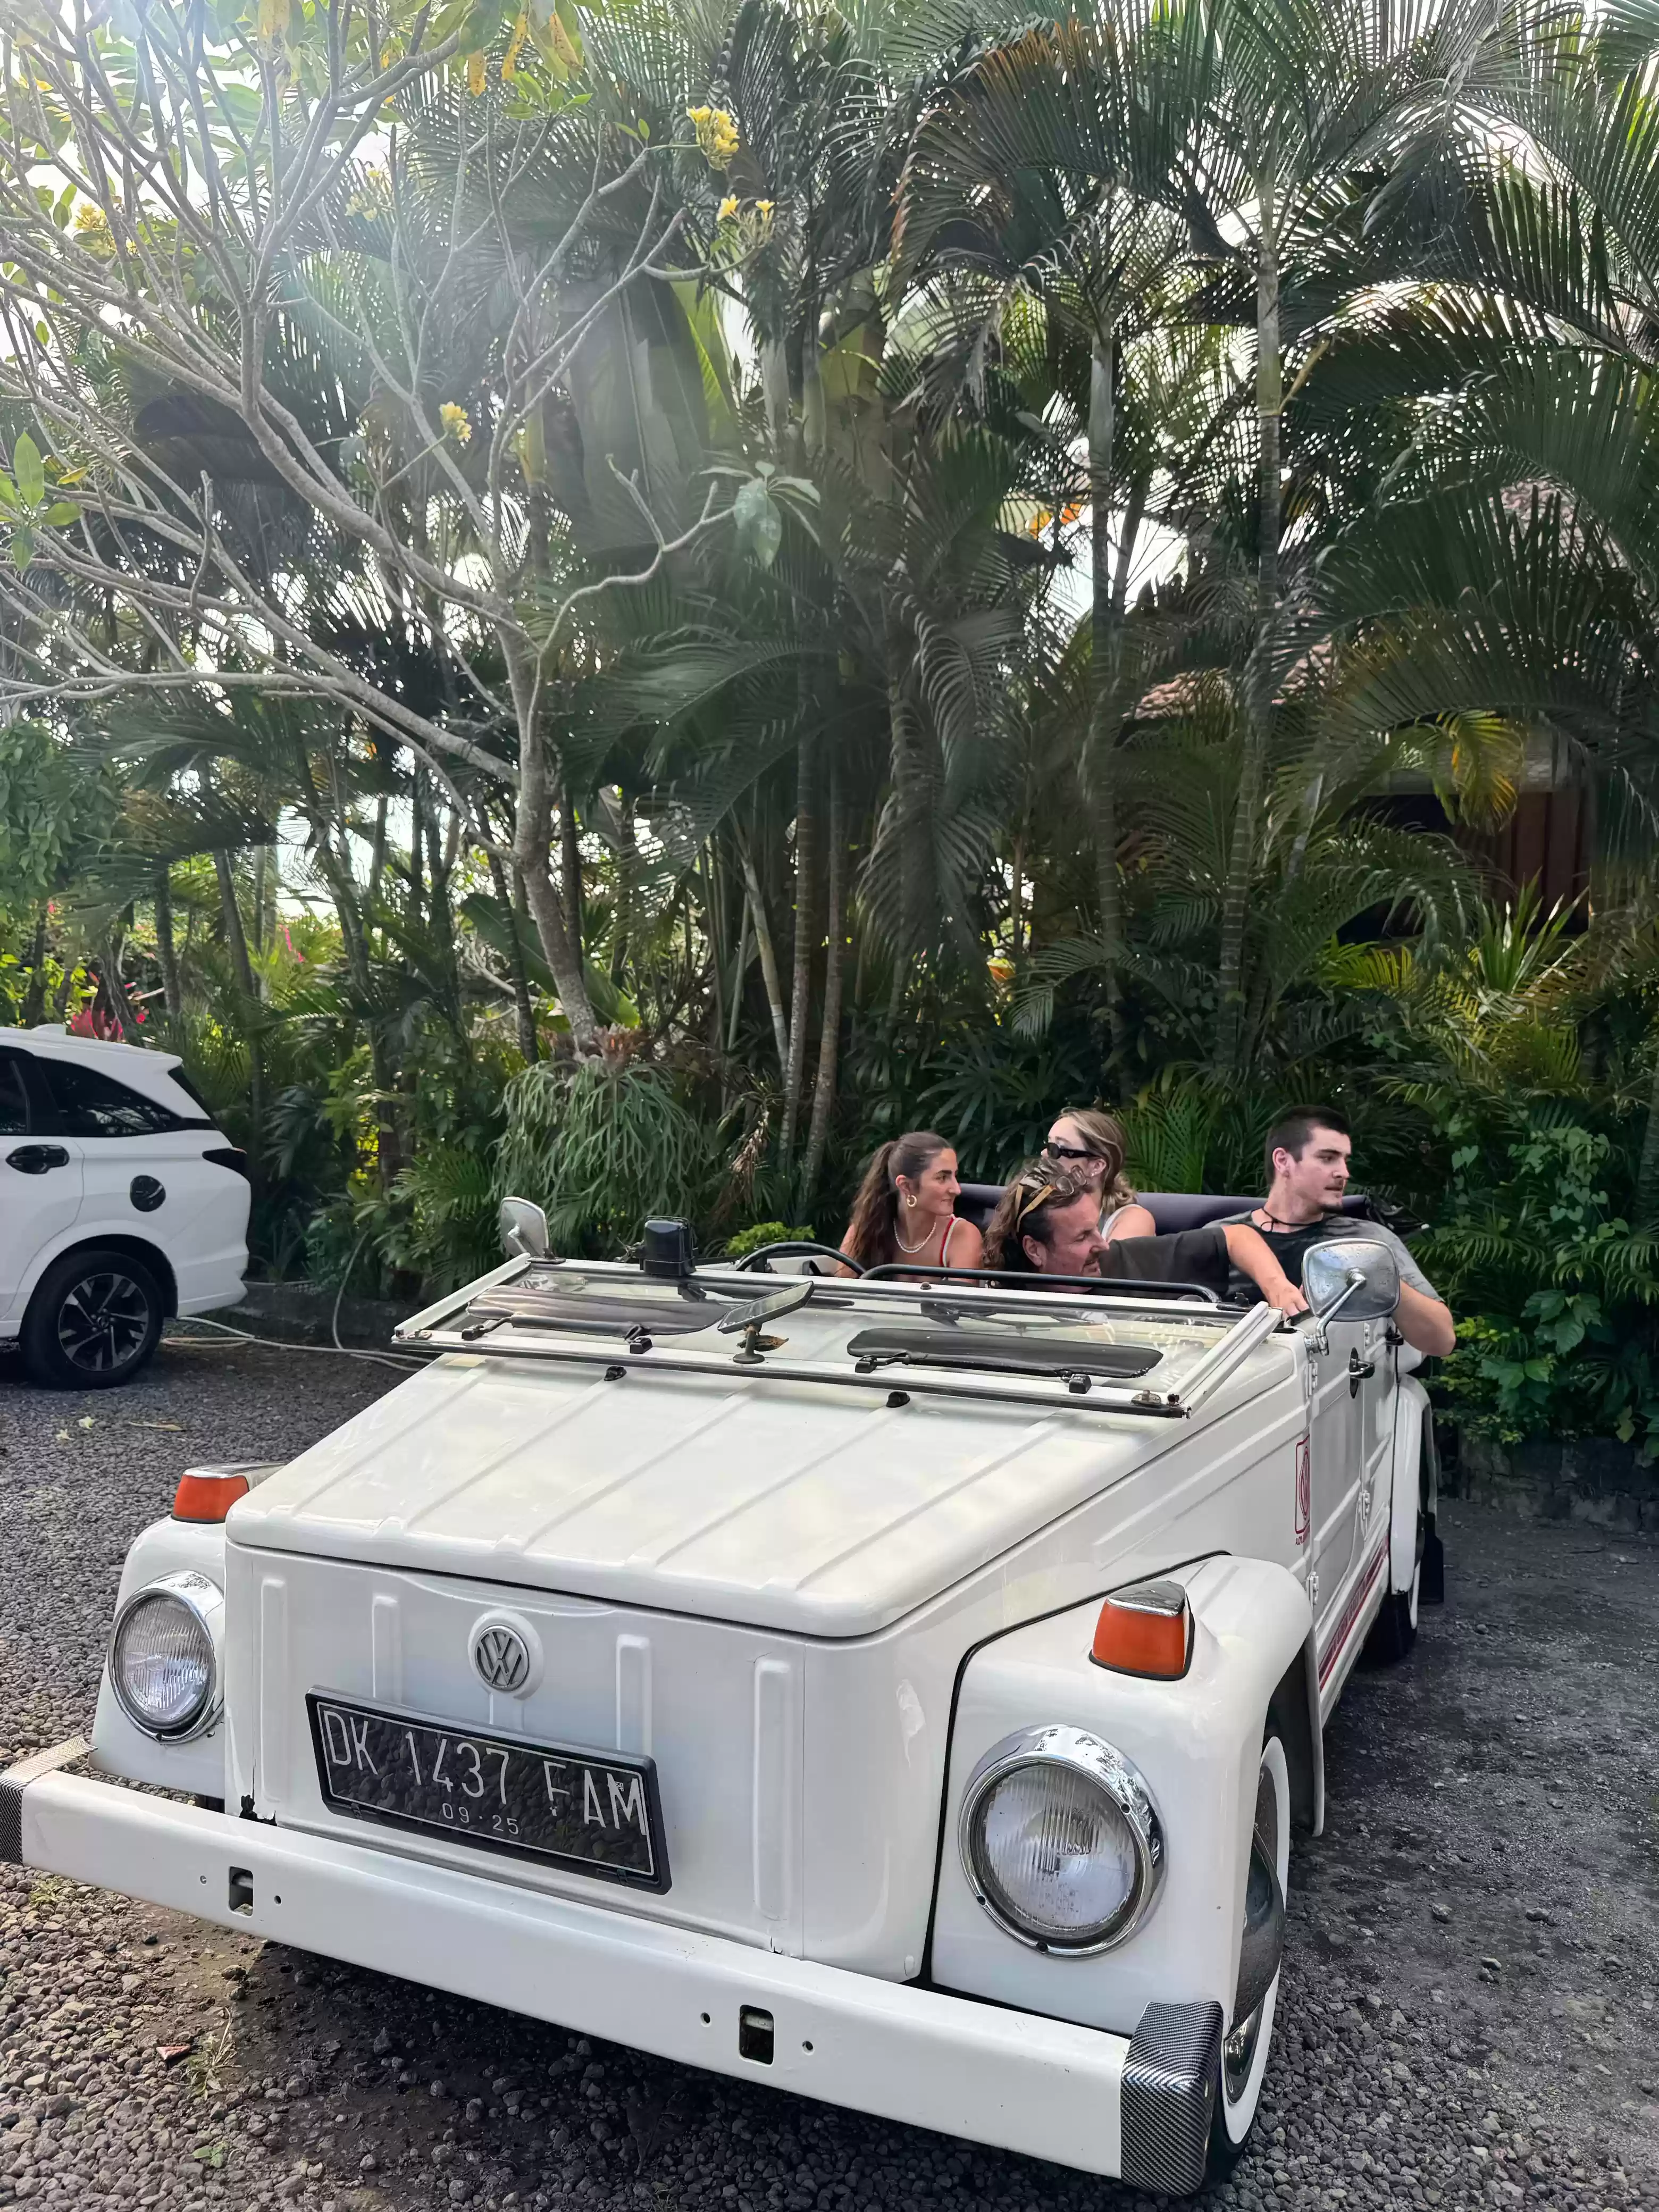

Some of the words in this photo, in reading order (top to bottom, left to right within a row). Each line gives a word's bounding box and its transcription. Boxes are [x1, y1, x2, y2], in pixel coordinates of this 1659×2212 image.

[475, 1626, 530, 1690] VW
[324, 1711, 378, 1774] DK
[406, 1732, 508, 1804] 1437
[544, 1761, 647, 1836] FAM
[442, 1803, 470, 1823] 09
[493, 1815, 519, 1835] 25
